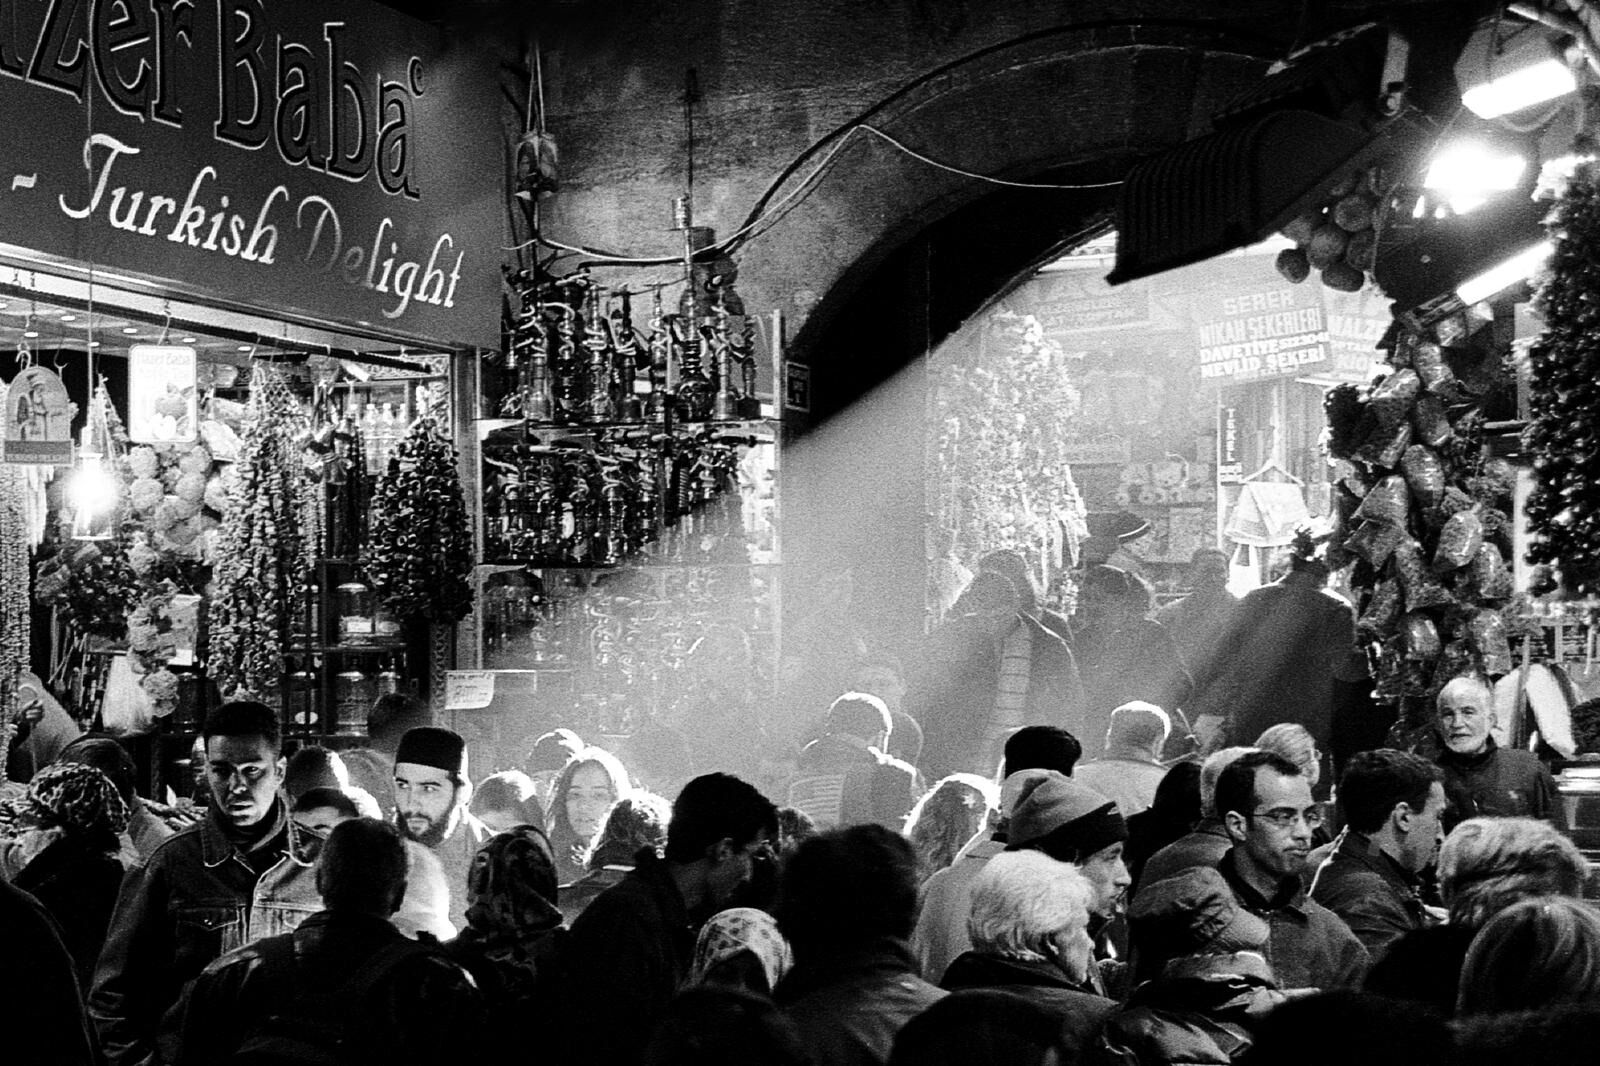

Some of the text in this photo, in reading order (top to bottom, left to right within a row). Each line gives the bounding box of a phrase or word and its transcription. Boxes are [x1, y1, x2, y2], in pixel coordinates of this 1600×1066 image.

[59, 132, 290, 265] Turkish
[296, 195, 465, 319] Delight
[1226, 407, 1236, 462] TEKEL
